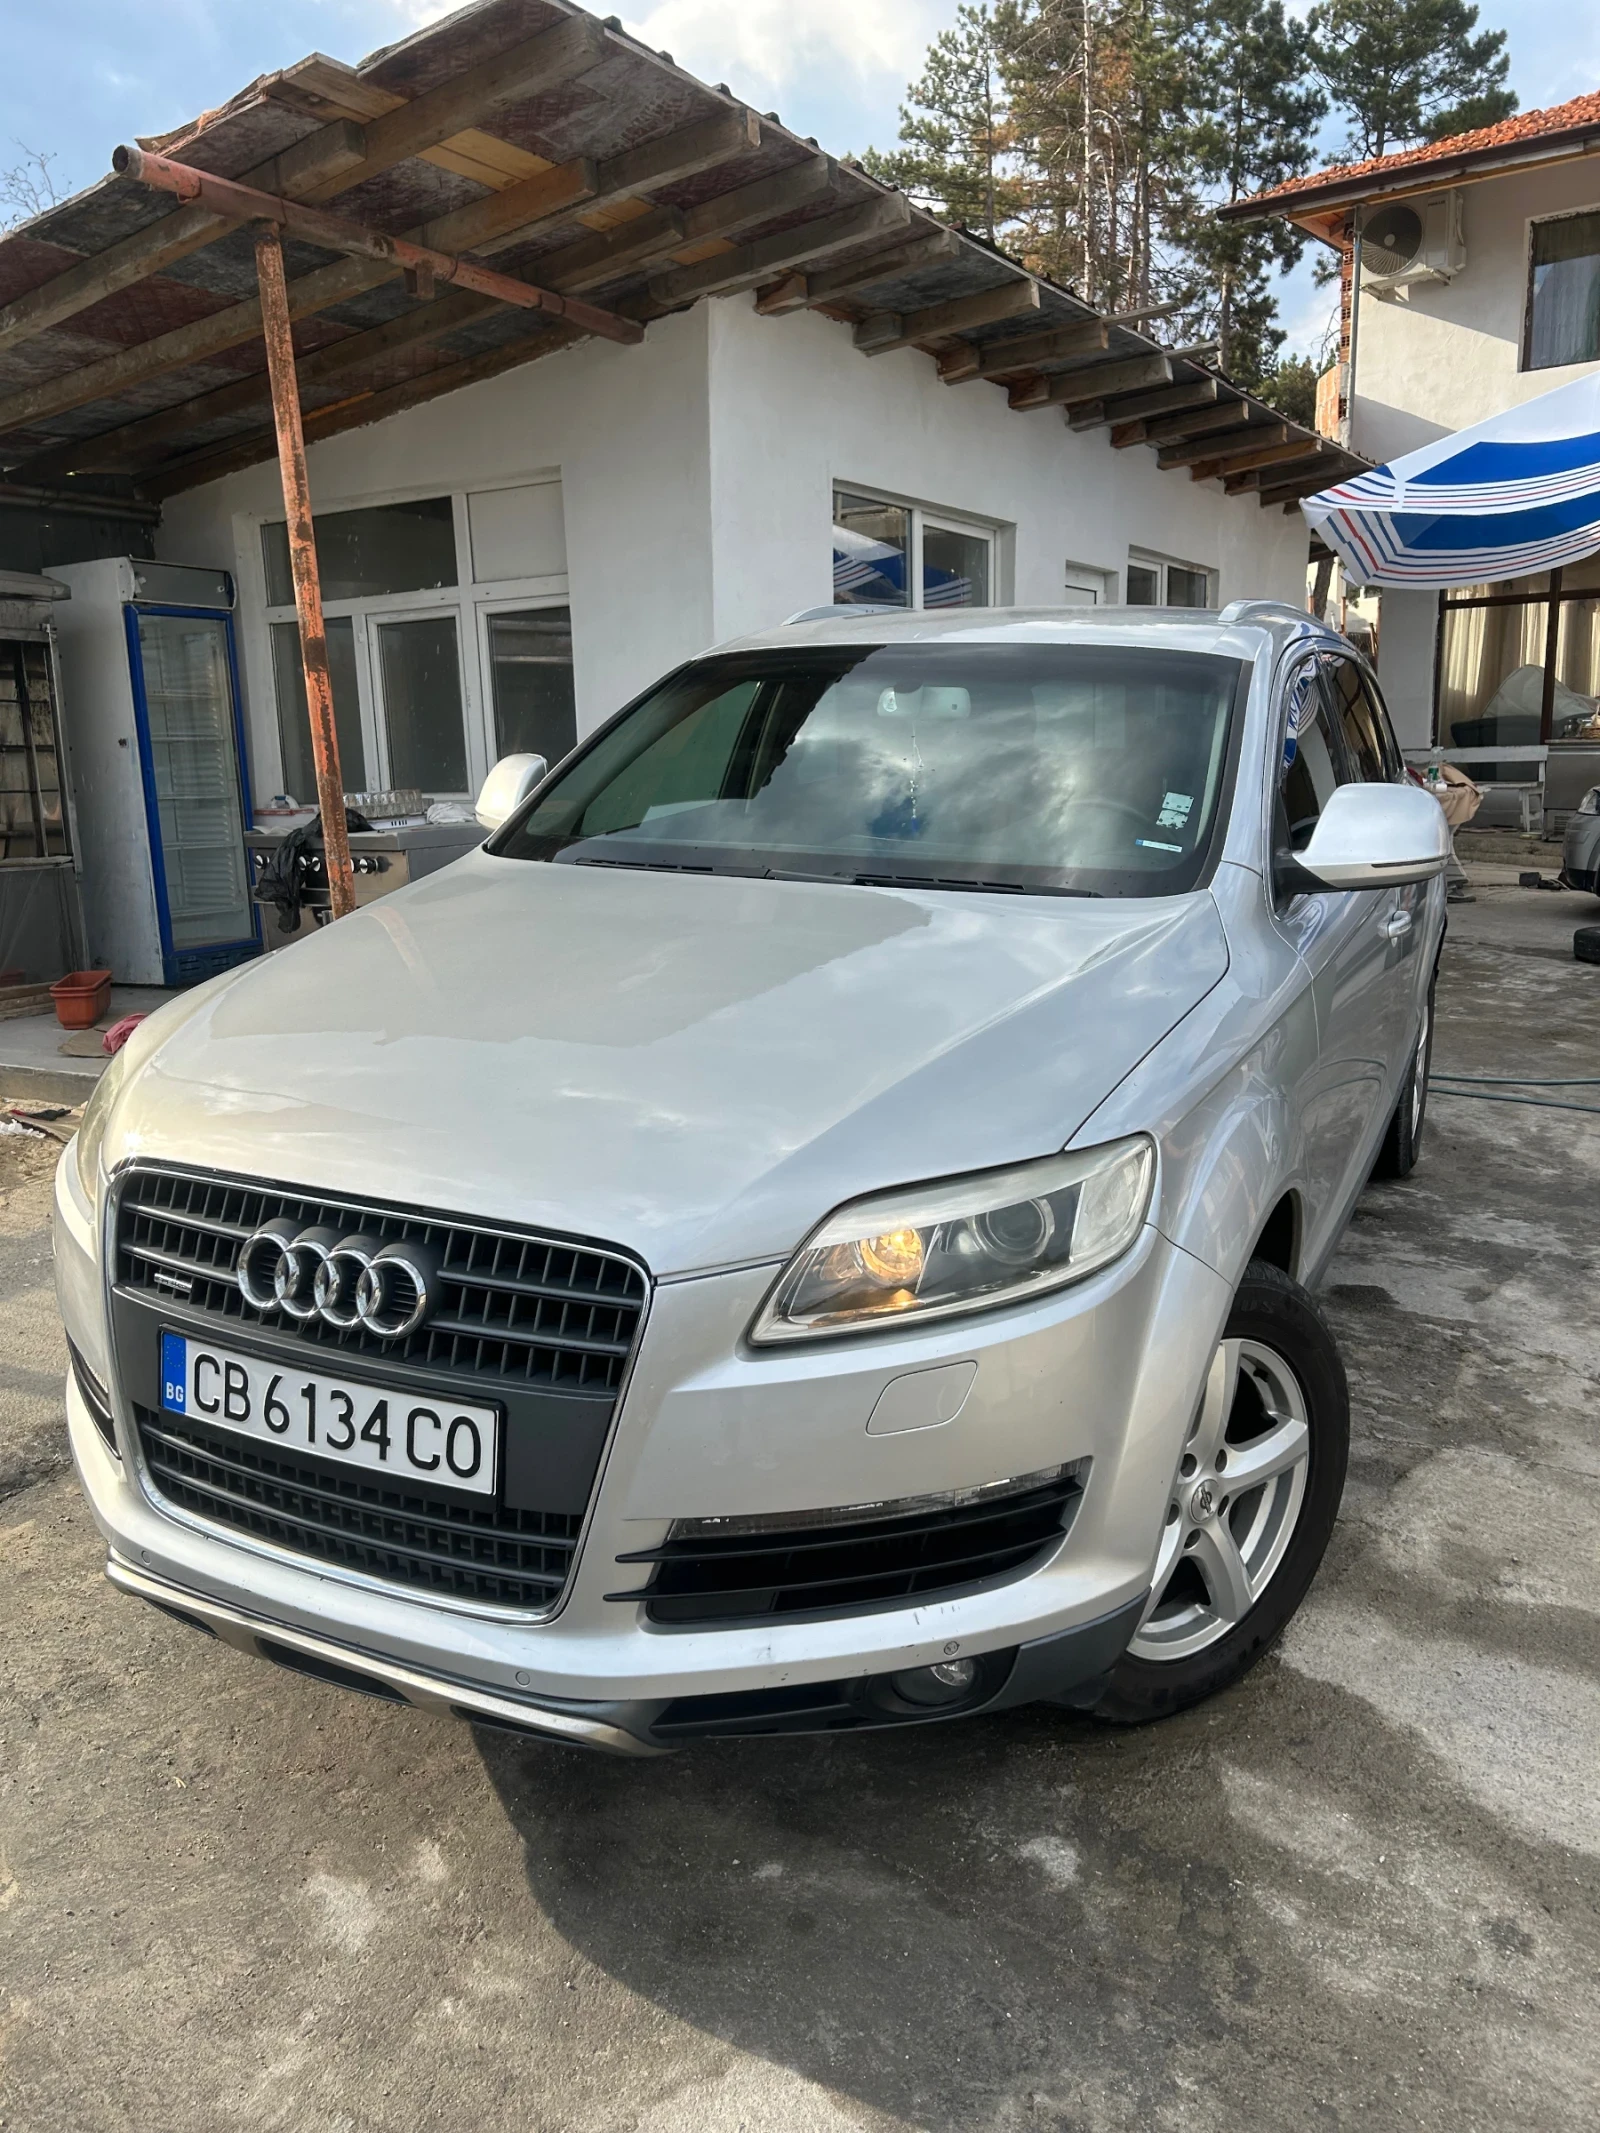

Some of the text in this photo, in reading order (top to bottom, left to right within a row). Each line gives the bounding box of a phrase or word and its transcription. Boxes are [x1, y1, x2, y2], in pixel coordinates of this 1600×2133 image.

[166, 1382, 184, 1403] BG
[194, 1353, 482, 1478] CB 6134 CO
